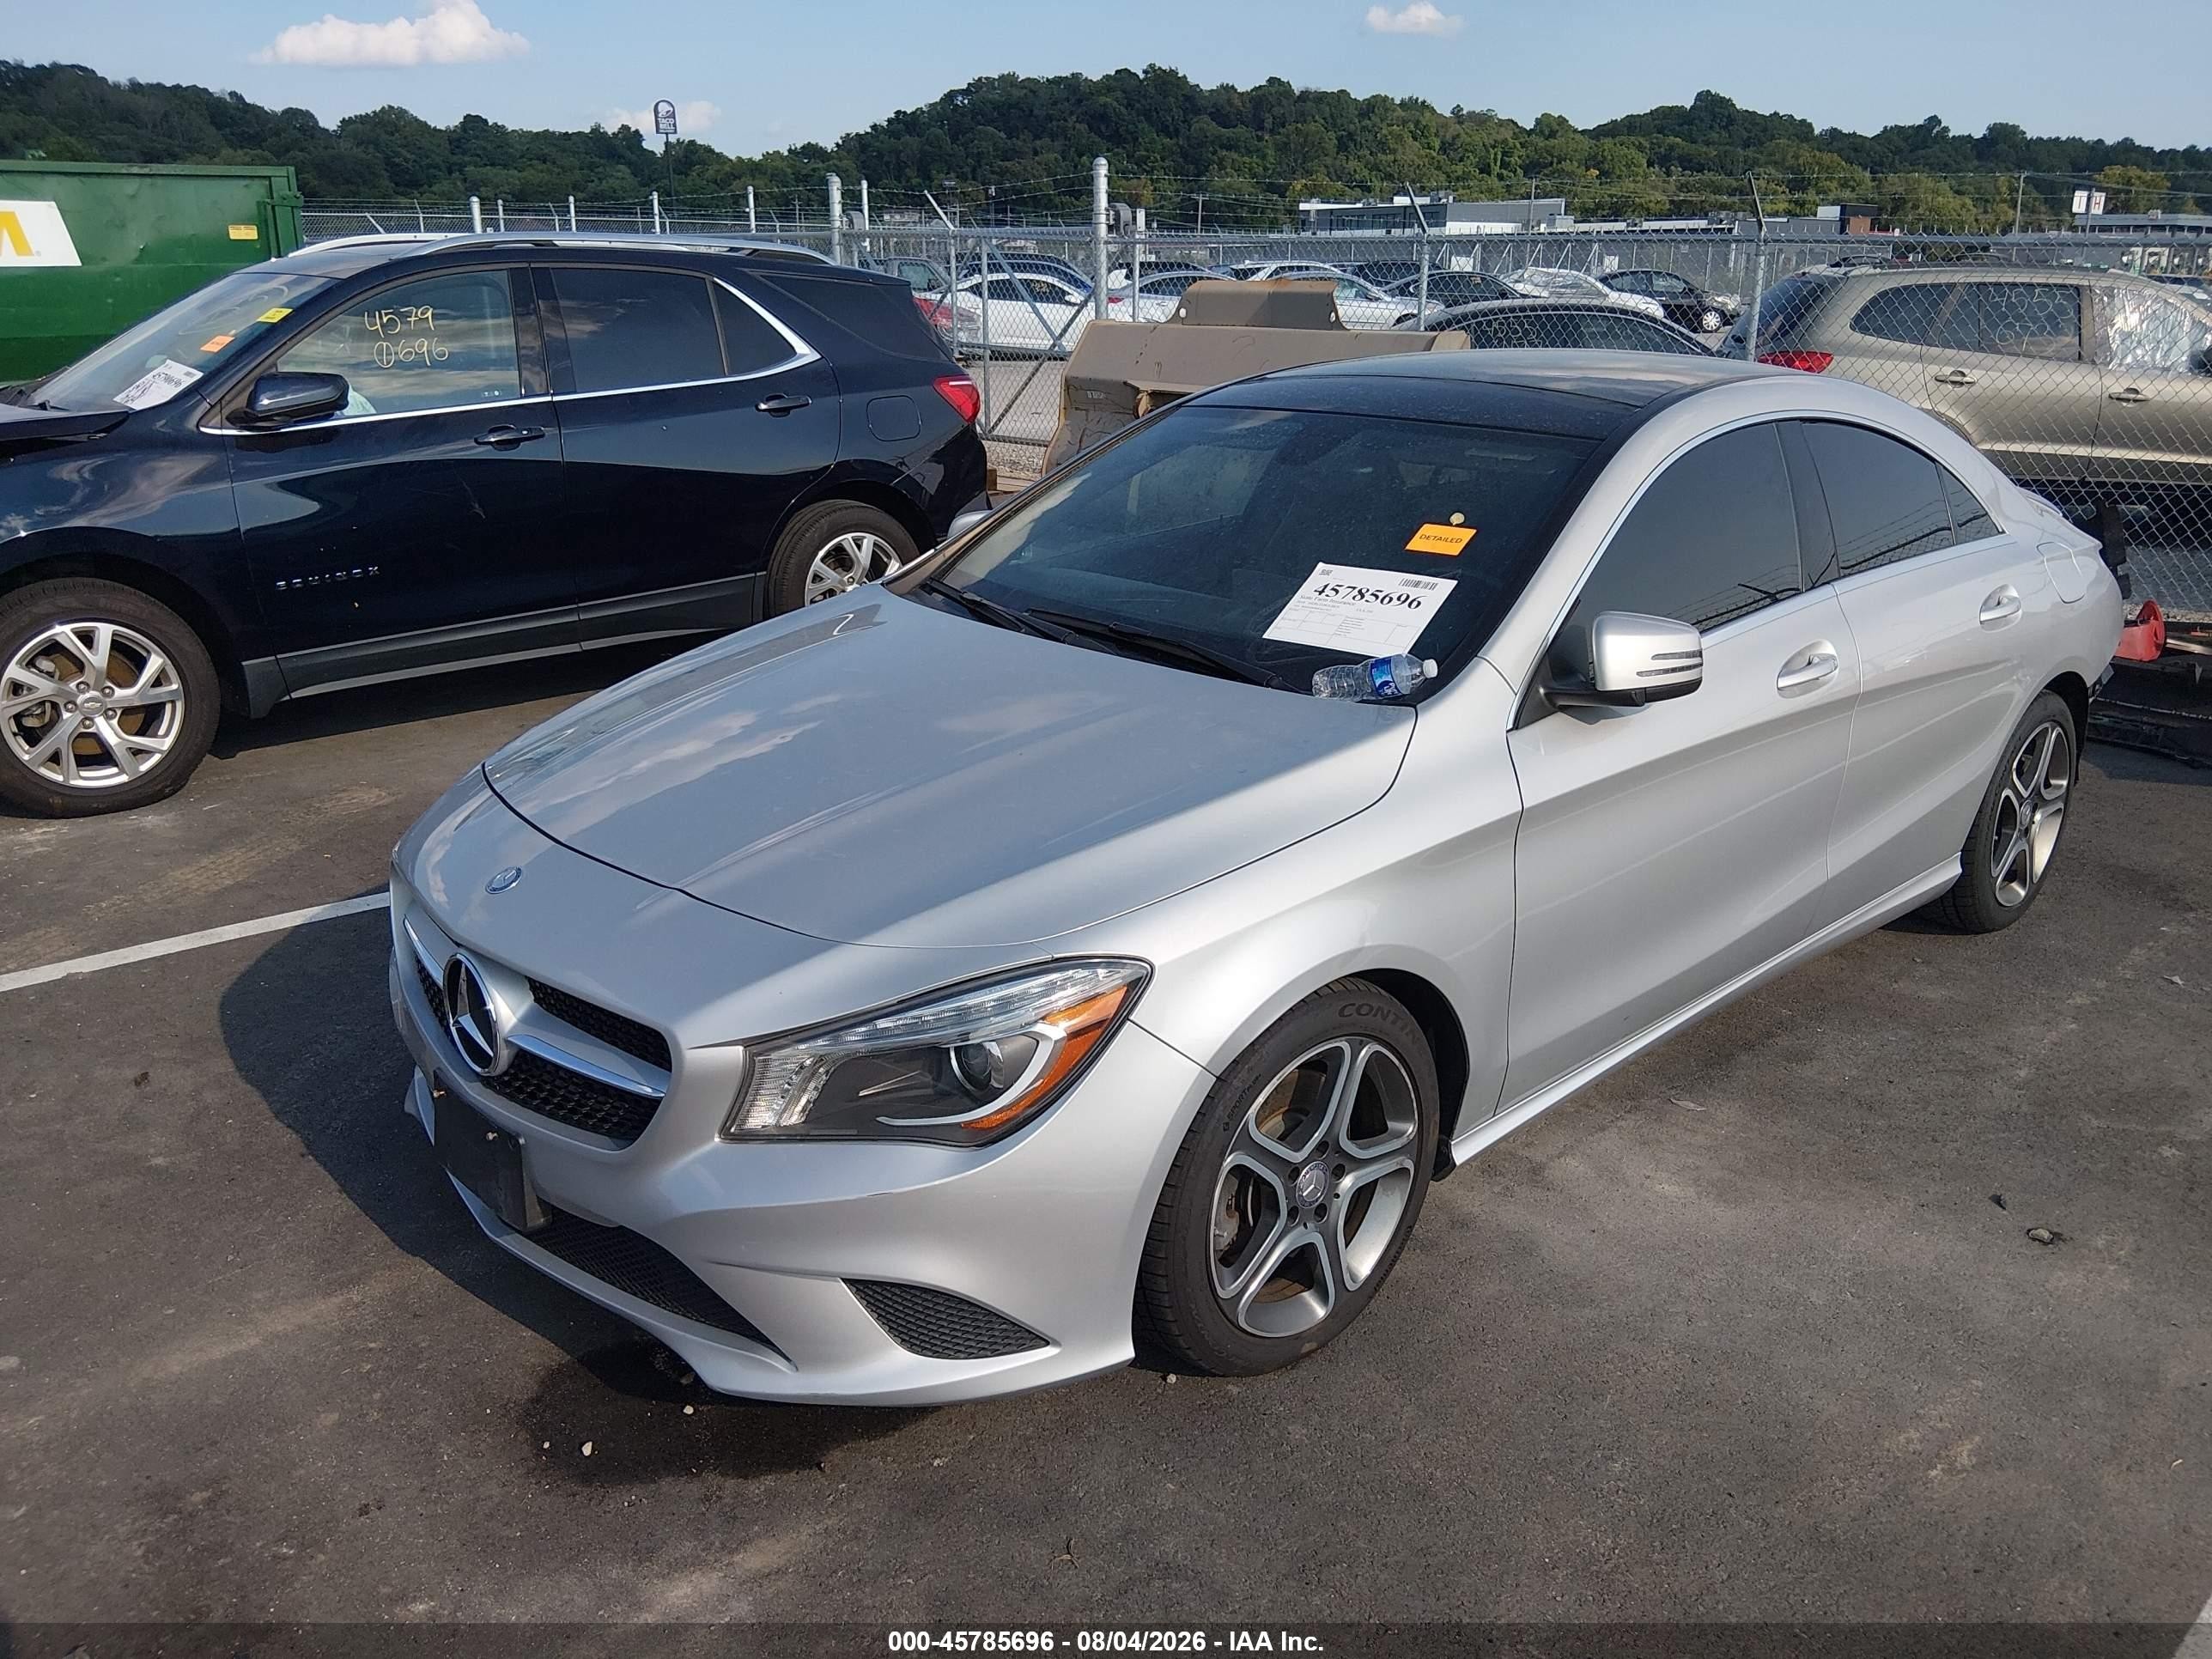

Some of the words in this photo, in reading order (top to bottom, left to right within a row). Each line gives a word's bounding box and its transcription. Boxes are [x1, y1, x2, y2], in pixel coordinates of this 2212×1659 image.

[365, 305, 435, 338] 4579
[1419, 533, 1463, 544] DETAILED
[275, 565, 380, 591] EQUINOX
[1313, 582, 1429, 610] 45785696
